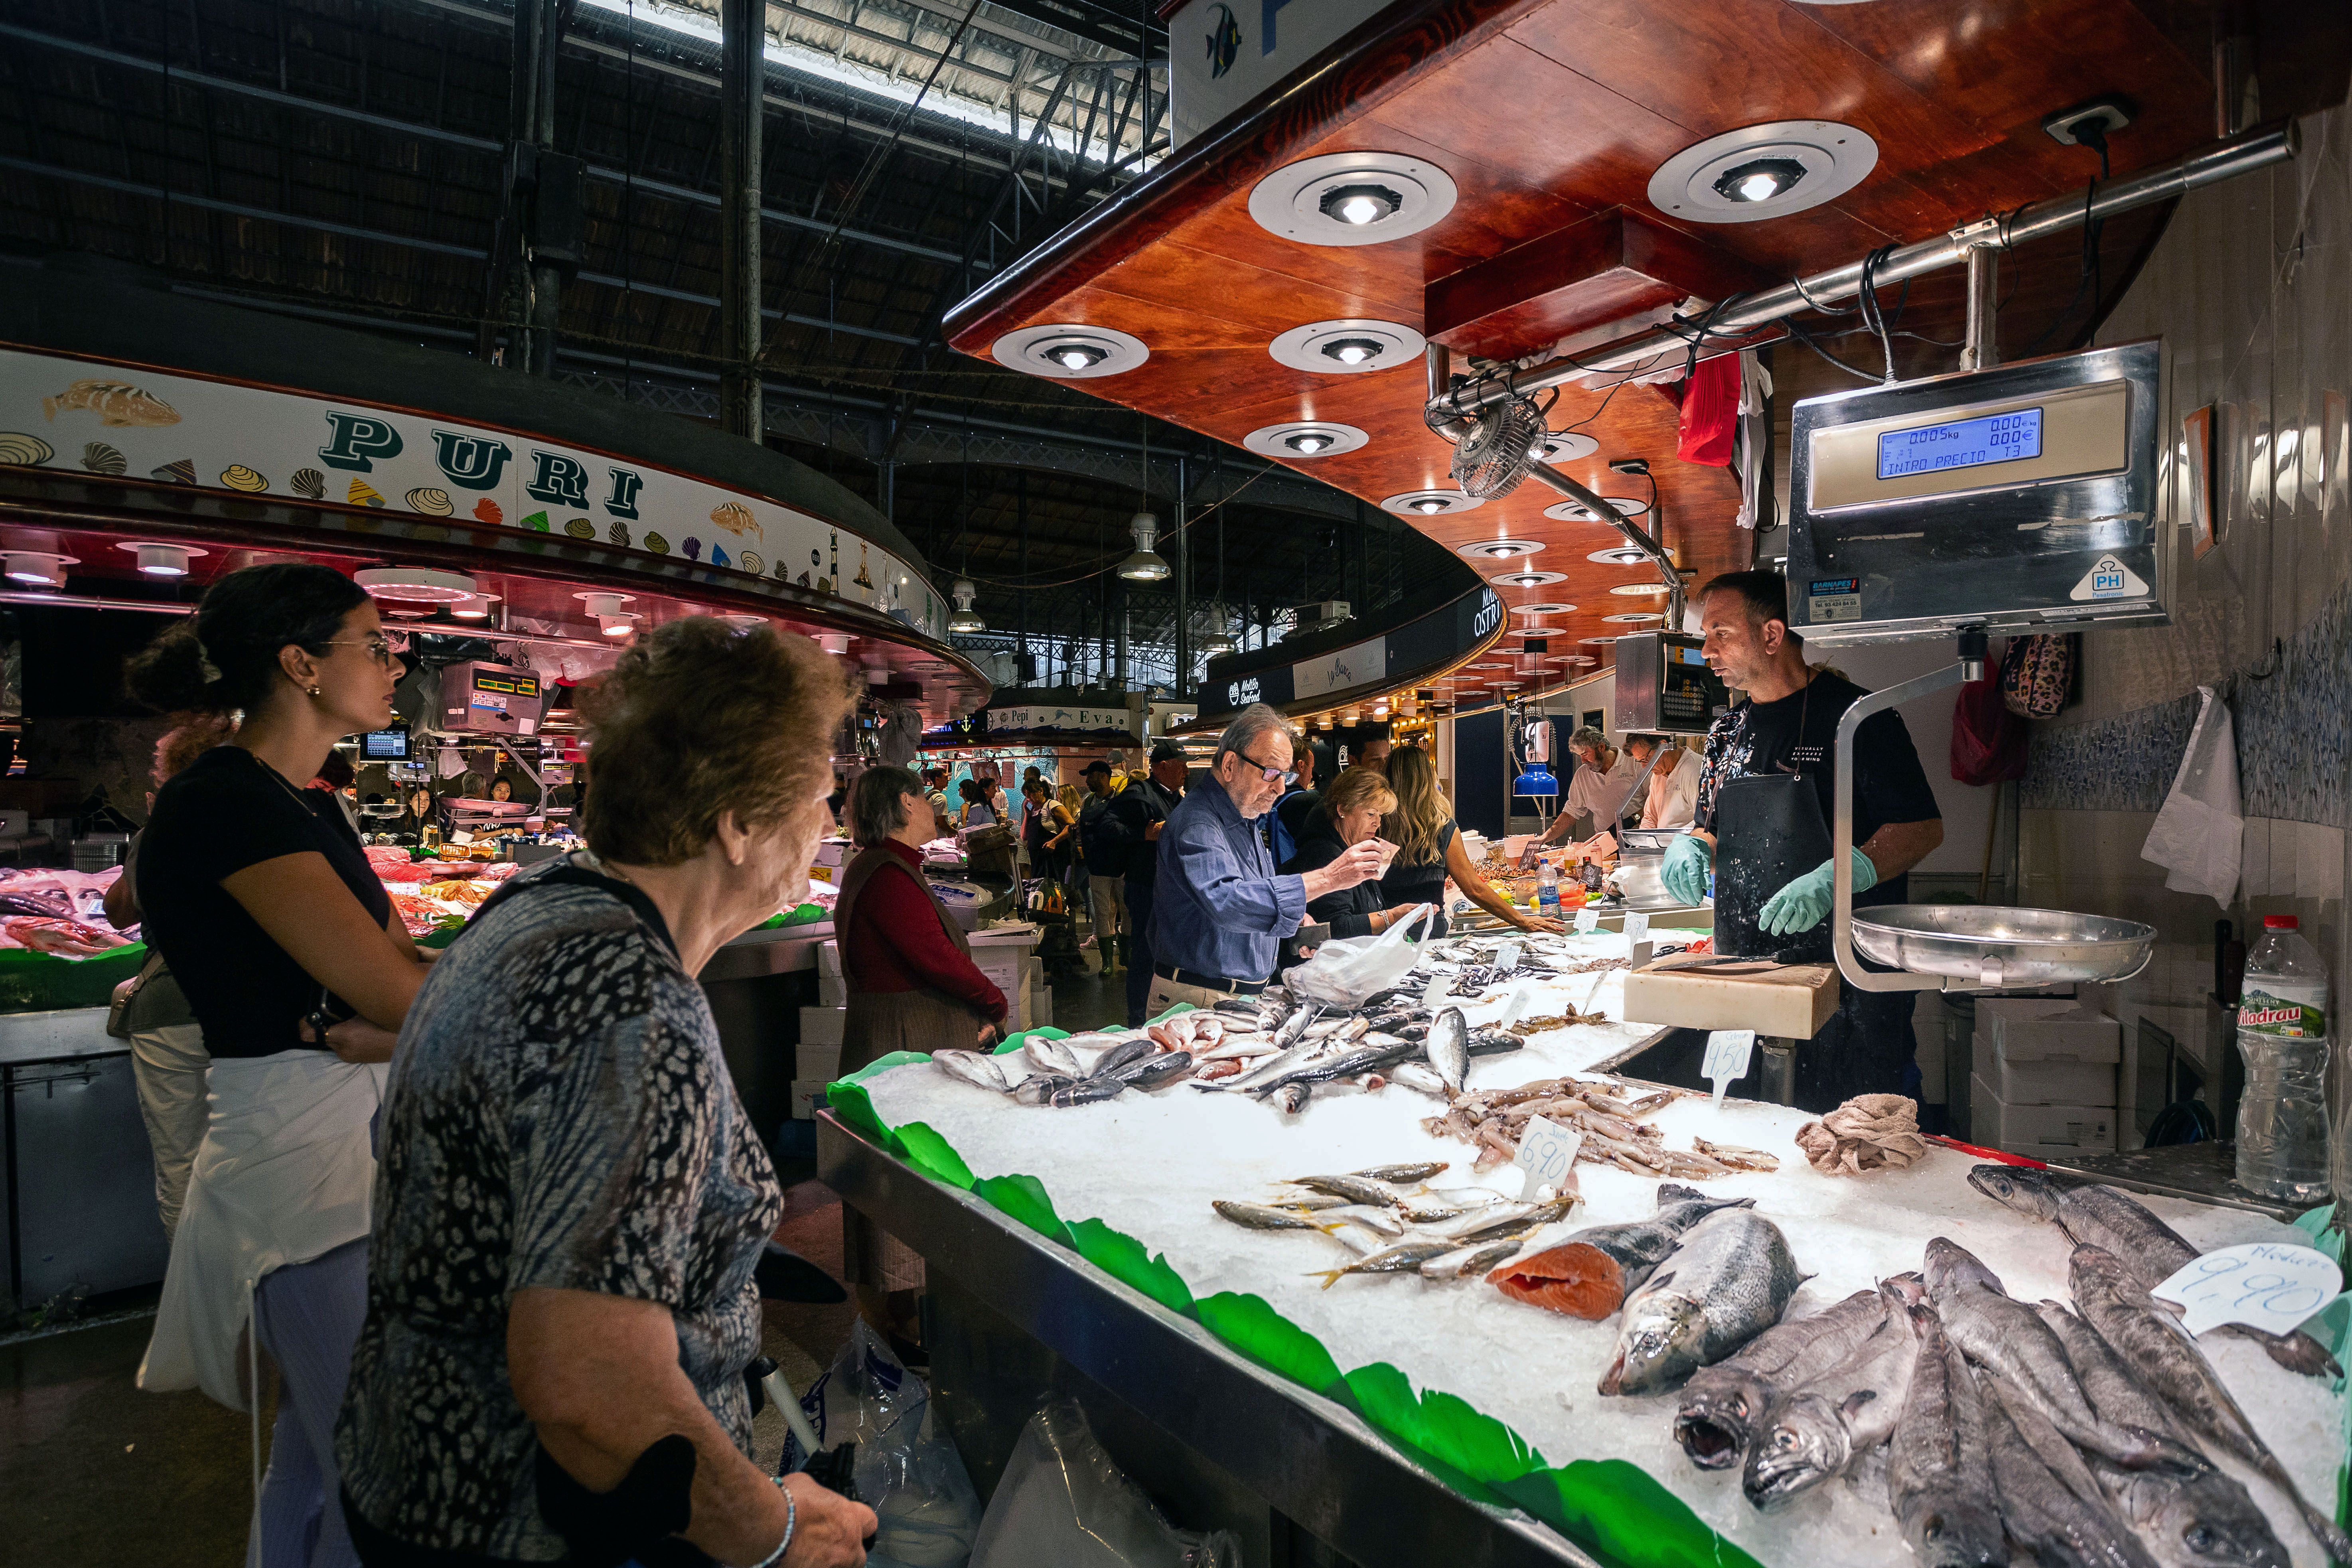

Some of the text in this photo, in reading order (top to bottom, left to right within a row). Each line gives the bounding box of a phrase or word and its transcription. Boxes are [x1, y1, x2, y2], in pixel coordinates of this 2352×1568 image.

[318, 409, 643, 520] PURI
[1888, 459, 1927, 475] INTRO
[1936, 450, 1986, 467] PRECIO
[1813, 580, 1851, 589] BARNAPES
[2097, 574, 2119, 588] PH
[1327, 657, 1352, 688] La Barca
[1241, 678, 1258, 692] MoltBo
[1240, 689, 1260, 704] SeaFood
[1012, 709, 1113, 724] Pepi Eva
[2245, 996, 2279, 1005] MONTSENY
[2237, 1006, 2301, 1026] Viladrau
[1709, 1041, 1746, 1079] 9,50
[1523, 1132, 1566, 1179] 6,90
[2181, 1256, 2324, 1315] 9,90
